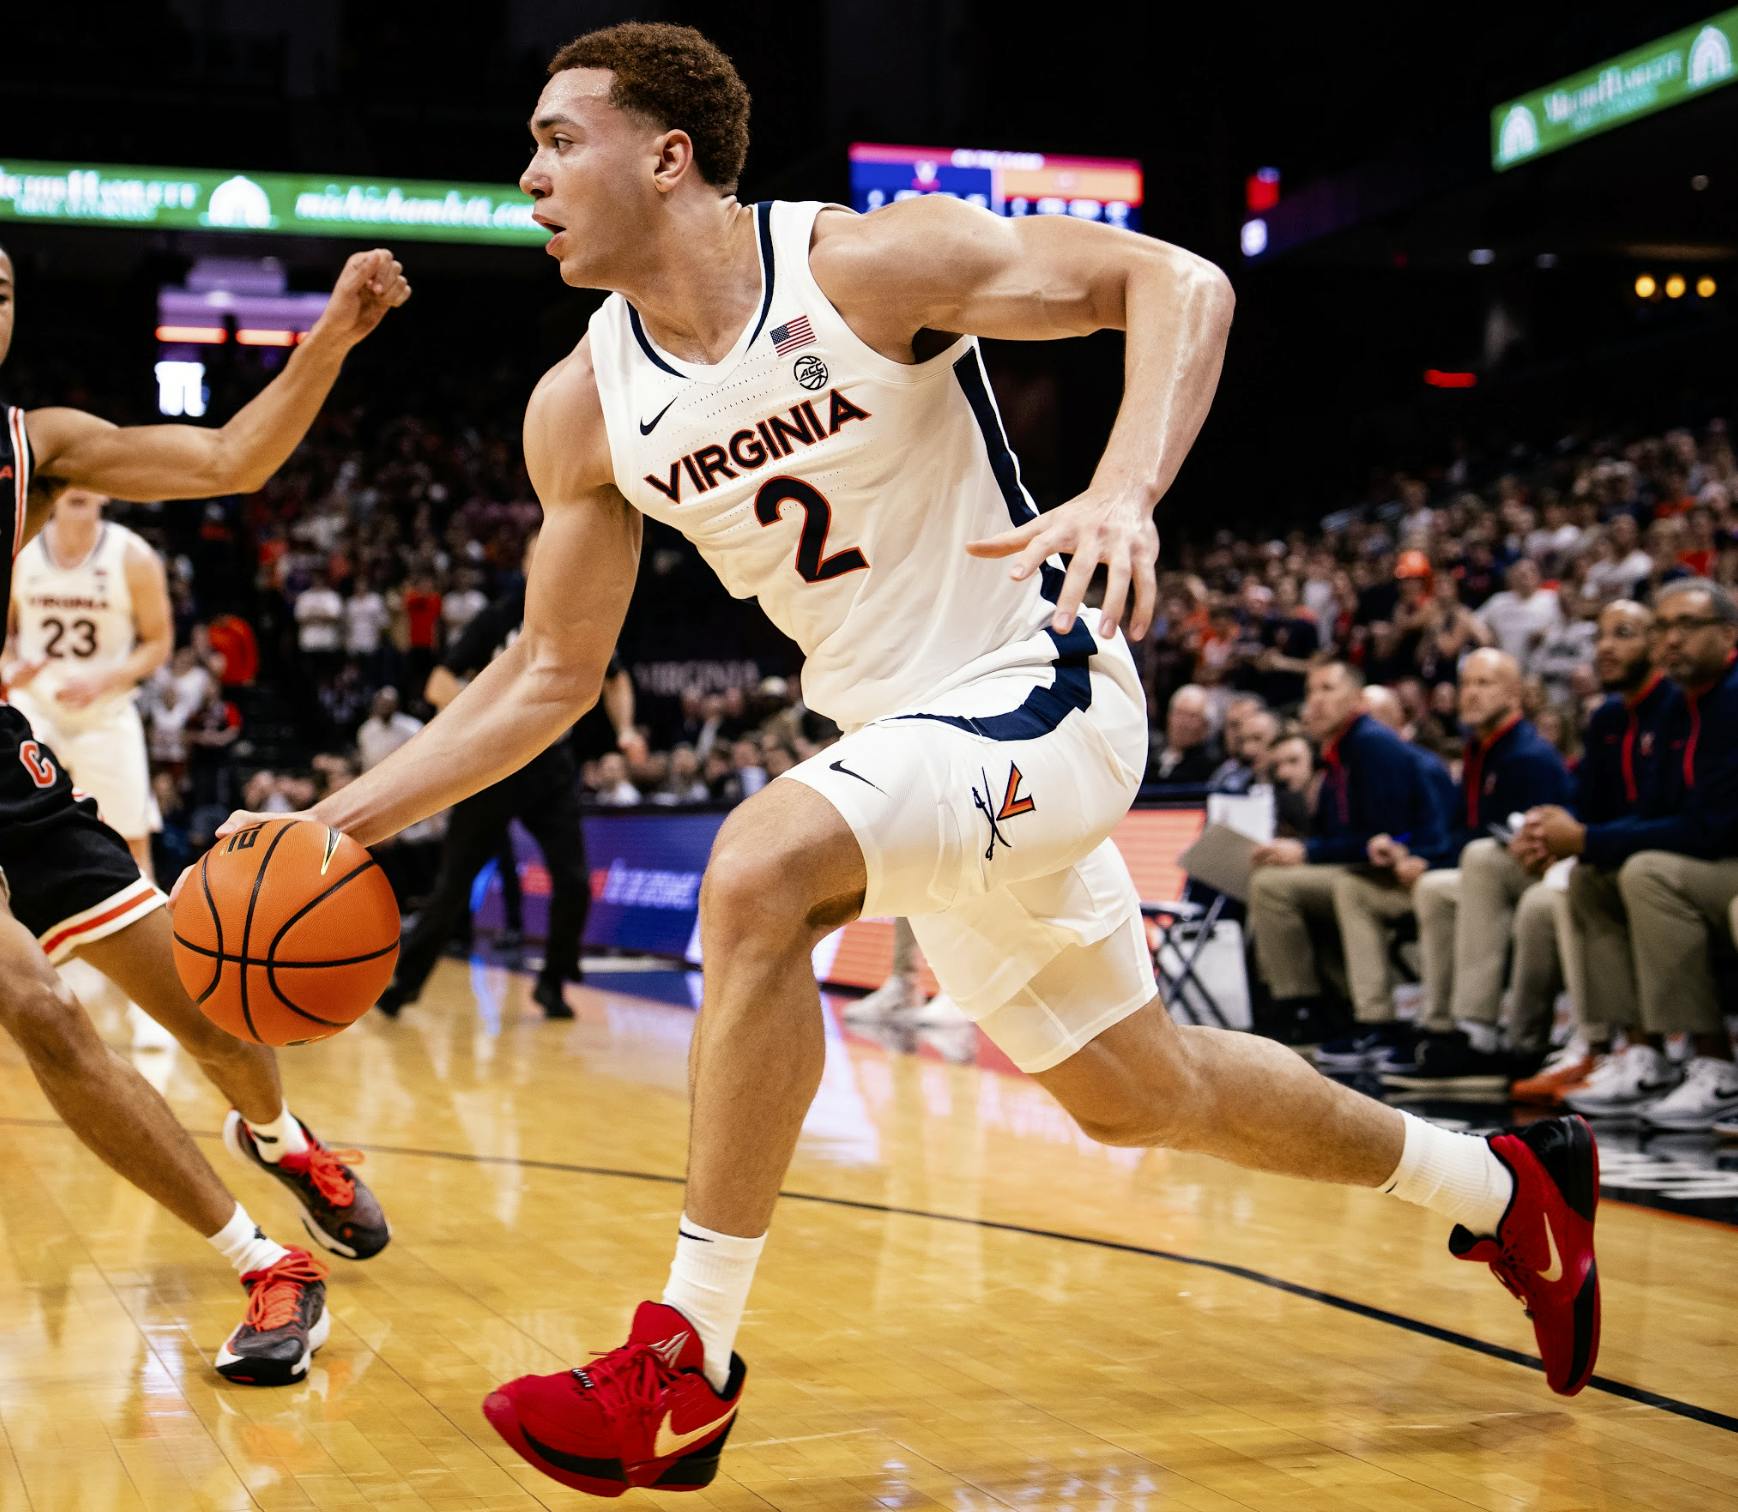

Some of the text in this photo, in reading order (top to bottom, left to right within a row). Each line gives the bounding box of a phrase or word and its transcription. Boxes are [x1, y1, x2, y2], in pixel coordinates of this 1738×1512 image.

[800, 361, 824, 379] ACC
[643, 388, 872, 504] VIRGINIA
[754, 475, 870, 583] 2
[41, 617, 97, 658] 23
[19, 740, 57, 788] C
